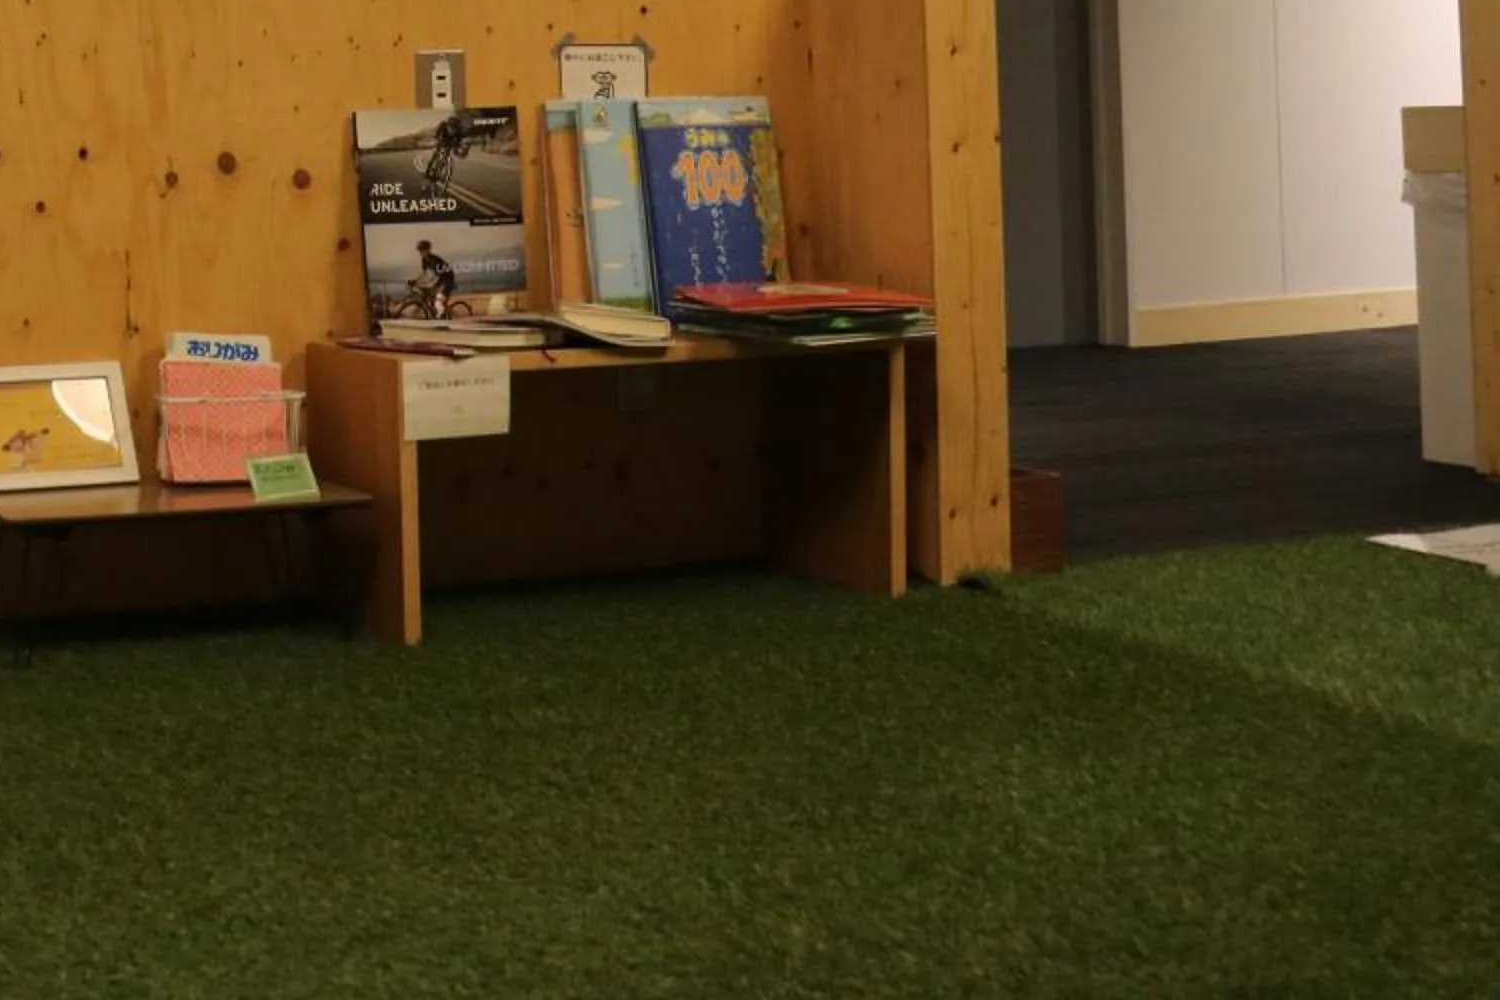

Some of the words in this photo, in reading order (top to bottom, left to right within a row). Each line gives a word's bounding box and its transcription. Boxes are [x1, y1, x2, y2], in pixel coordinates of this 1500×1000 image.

[673, 150, 746, 207] 100
[369, 183, 404, 197] RIDE
[370, 199, 457, 214] UNLEASHED
[187, 340, 260, 362] おりがみ
